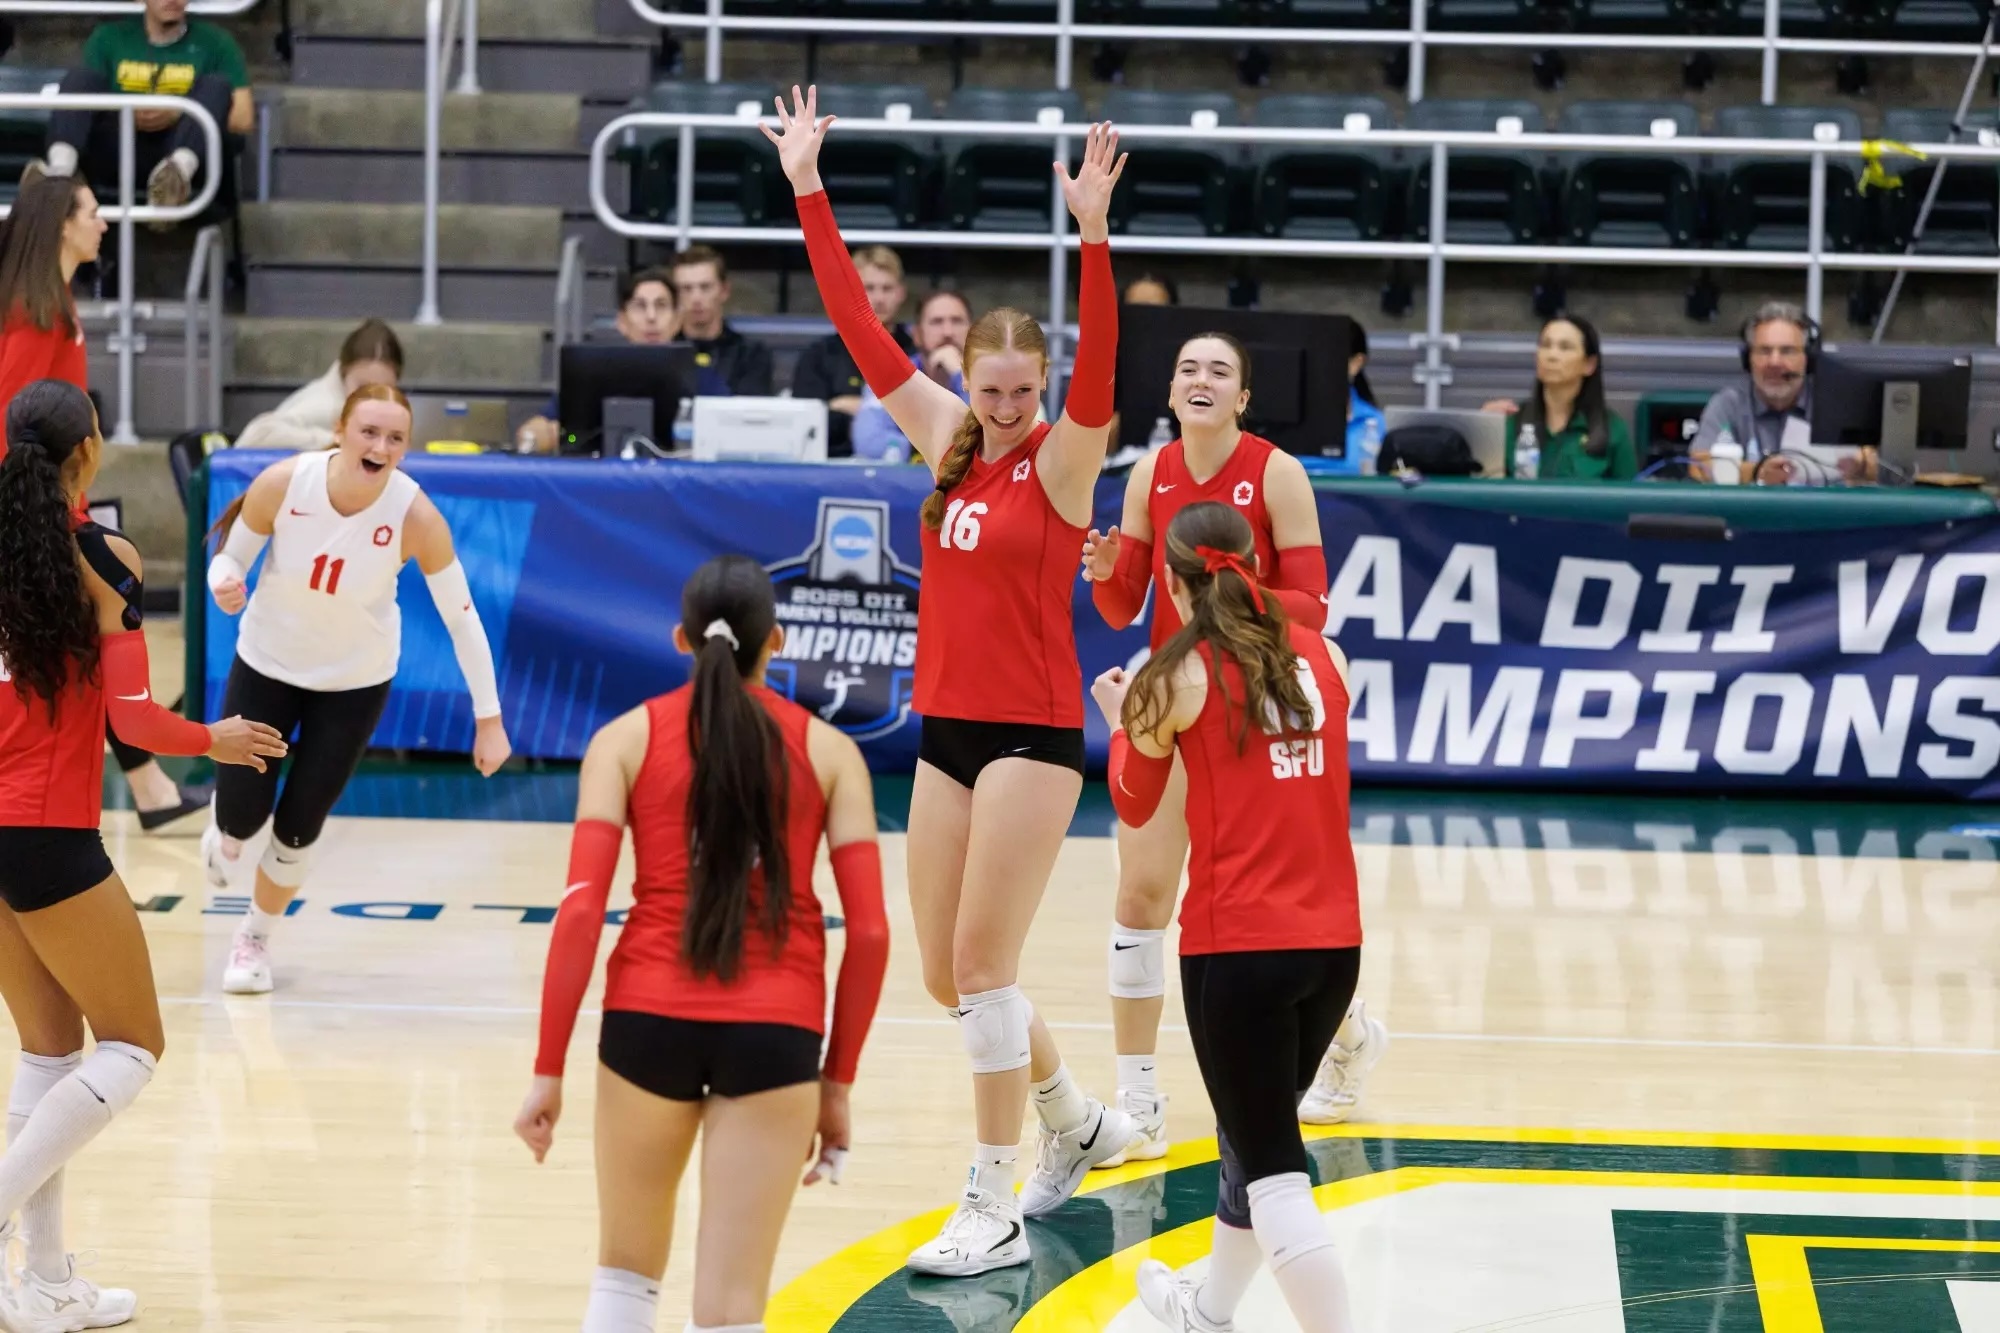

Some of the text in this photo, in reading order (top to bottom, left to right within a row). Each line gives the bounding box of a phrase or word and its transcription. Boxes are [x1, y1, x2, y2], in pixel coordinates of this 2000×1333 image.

[939, 498, 989, 552] 16
[308, 553, 346, 596] 11
[791, 586, 907, 611] 2025 DII
[838, 607, 919, 628] VOLLEYB
[1538, 555, 1796, 653] DII
[1837, 551, 2000, 656] VO
[774, 624, 918, 668] MPIONS
[1347, 658, 2000, 780] AMPIONS
[1268, 737, 1325, 780] SFU
[965, 1191, 981, 1201] NIKE
